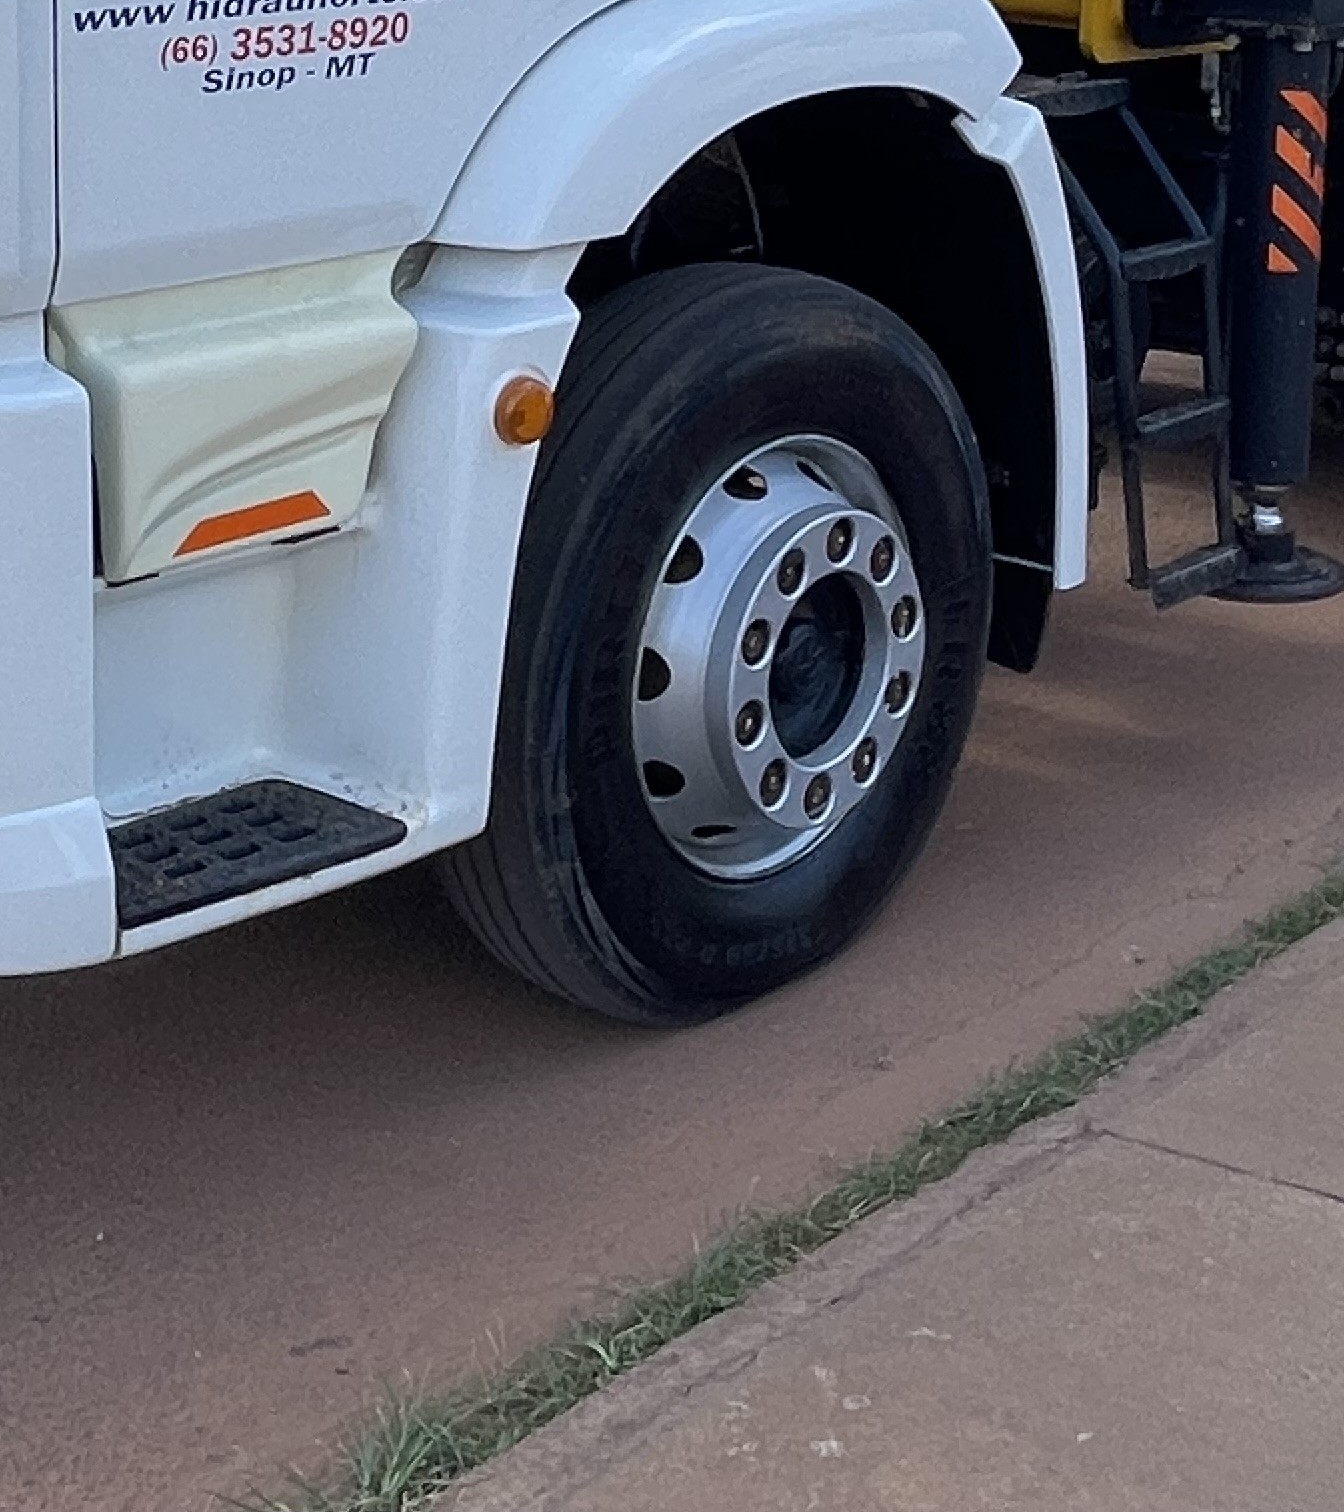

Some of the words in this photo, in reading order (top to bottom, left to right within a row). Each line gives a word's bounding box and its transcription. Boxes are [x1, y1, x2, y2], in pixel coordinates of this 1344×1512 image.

[161, 34, 218, 71] (66)
[230, 11, 410, 63] 3531-8920
[202, 65, 296, 94] Sinop
[325, 51, 377, 80] MT
